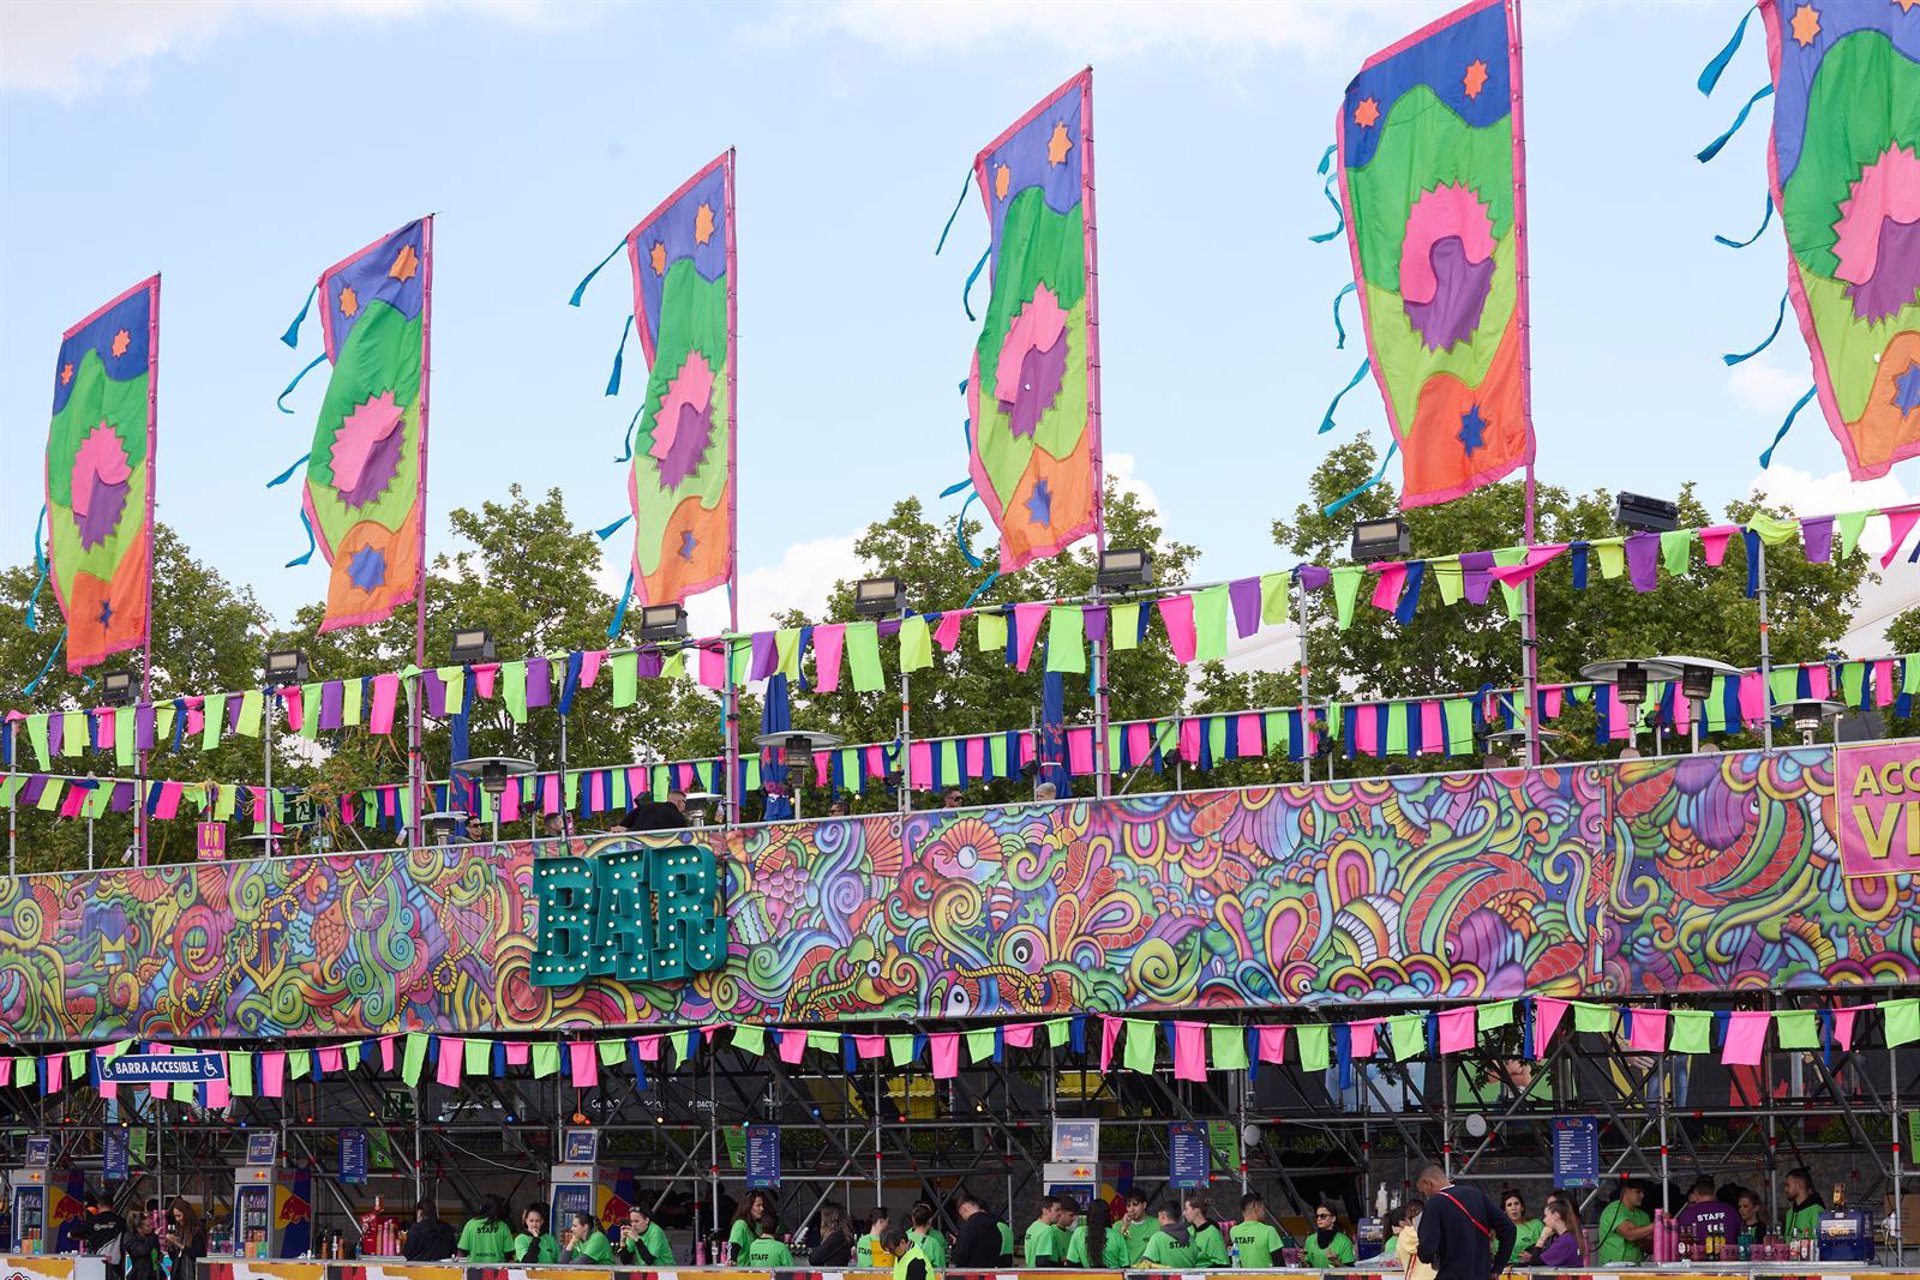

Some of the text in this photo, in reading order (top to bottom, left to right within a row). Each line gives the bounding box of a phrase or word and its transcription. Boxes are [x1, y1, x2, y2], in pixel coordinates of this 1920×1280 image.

[1851, 801, 1920, 859] VI
[530, 845, 727, 987] BAR
[115, 1061, 200, 1075] BARRA ACCESIBLE
[1697, 1212, 1726, 1222] STAFF
[1235, 1236, 1256, 1245] STAFF
[750, 1253, 769, 1261] STAFF
